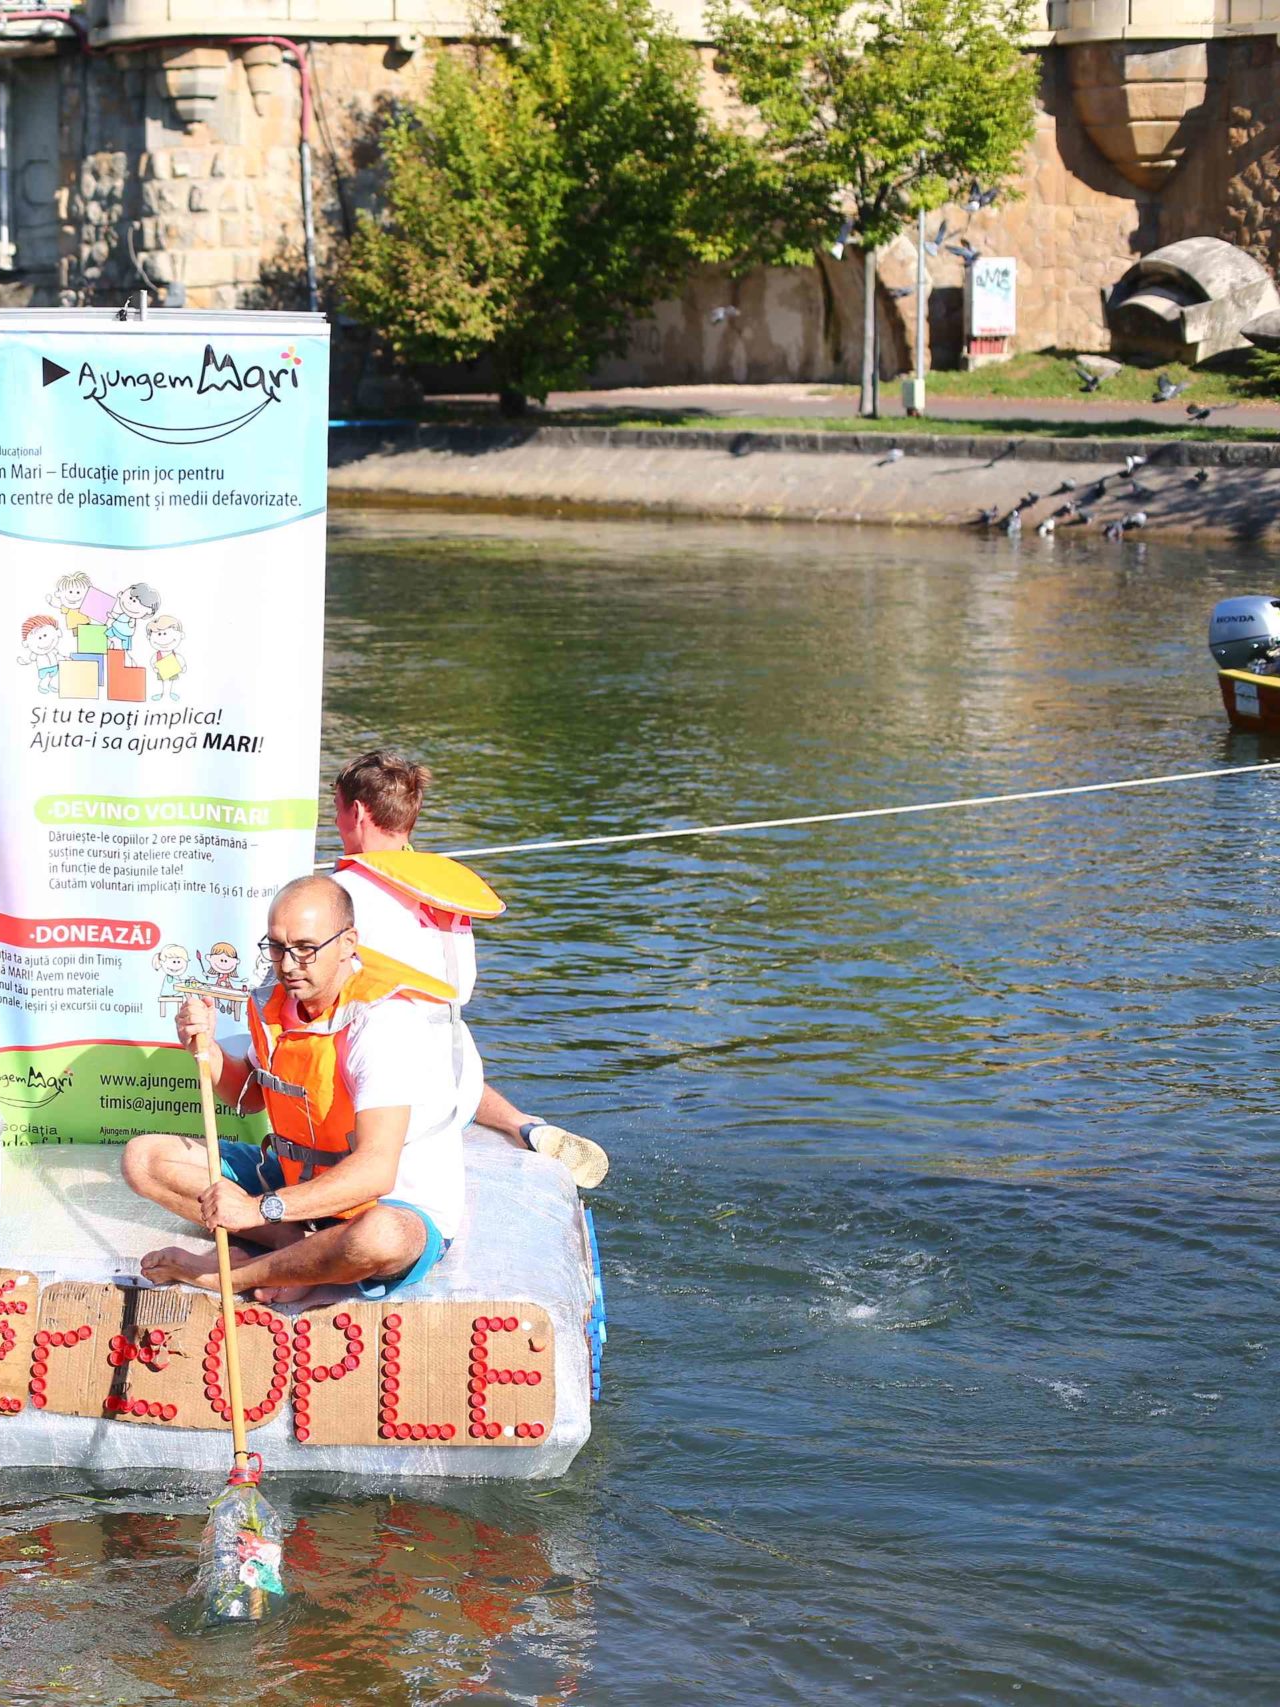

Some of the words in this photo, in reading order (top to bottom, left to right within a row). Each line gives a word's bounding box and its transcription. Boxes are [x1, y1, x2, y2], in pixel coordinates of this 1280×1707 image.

[78, 362, 193, 401] Ajungem
[196, 344, 299, 402] Mari
[11, 463, 42, 479] Mari
[123, 466, 150, 484] prin
[153, 466, 174, 484] joc
[178, 466, 224, 484] pentru
[10, 491, 54, 505] centre
[58, 488, 76, 505] de
[78, 489, 150, 508] plasament
[169, 491, 208, 506] medii
[212, 490, 302, 506] defavorizate.
[1216, 615, 1255, 624] HONDA
[52, 708, 71, 723] tu
[78, 708, 96, 724] te
[144, 707, 222, 729] implica!
[30, 731, 97, 752] Ajuta-i
[102, 735, 122, 750] sa
[128, 732, 197, 756] ajungă
[203, 732, 264, 754] MARI!
[112, 833, 149, 846] copiilor
[152, 833, 158, 845] 2
[160, 834, 177, 844] ore
[179, 834, 192, 846] pe
[87, 848, 121, 859] cursuri
[133, 849, 171, 861] ateliere
[173, 849, 215, 863] creative,
[98, 862, 111, 874] de
[113, 864, 158, 877] pasiunile
[161, 864, 184, 875] tale!
[48, 878, 87, 890] Căutăm
[90, 878, 134, 892] voluntari
[183, 880, 206, 892] între
[209, 882, 221, 895] 16
[231, 886, 243, 898] 61
[246, 887, 259, 898] de
[13, 953, 22, 963] ta
[24, 955, 50, 968] ajută
[52, 953, 76, 967] copii
[78, 953, 94, 965] din
[8, 965, 34, 980] MARI!
[36, 970, 64, 981] Avem
[66, 969, 100, 981] nevoie
[14, 983, 28, 996] tău
[30, 986, 64, 999] pentru
[66, 985, 114, 997] materiale
[60, 1000, 97, 1012] excursii
[99, 1002, 111, 1012] cu
[113, 1002, 143, 1016] copiii!
[27, 1066, 72, 1093] Mari
[100, 1126, 129, 1137] Ajungem
